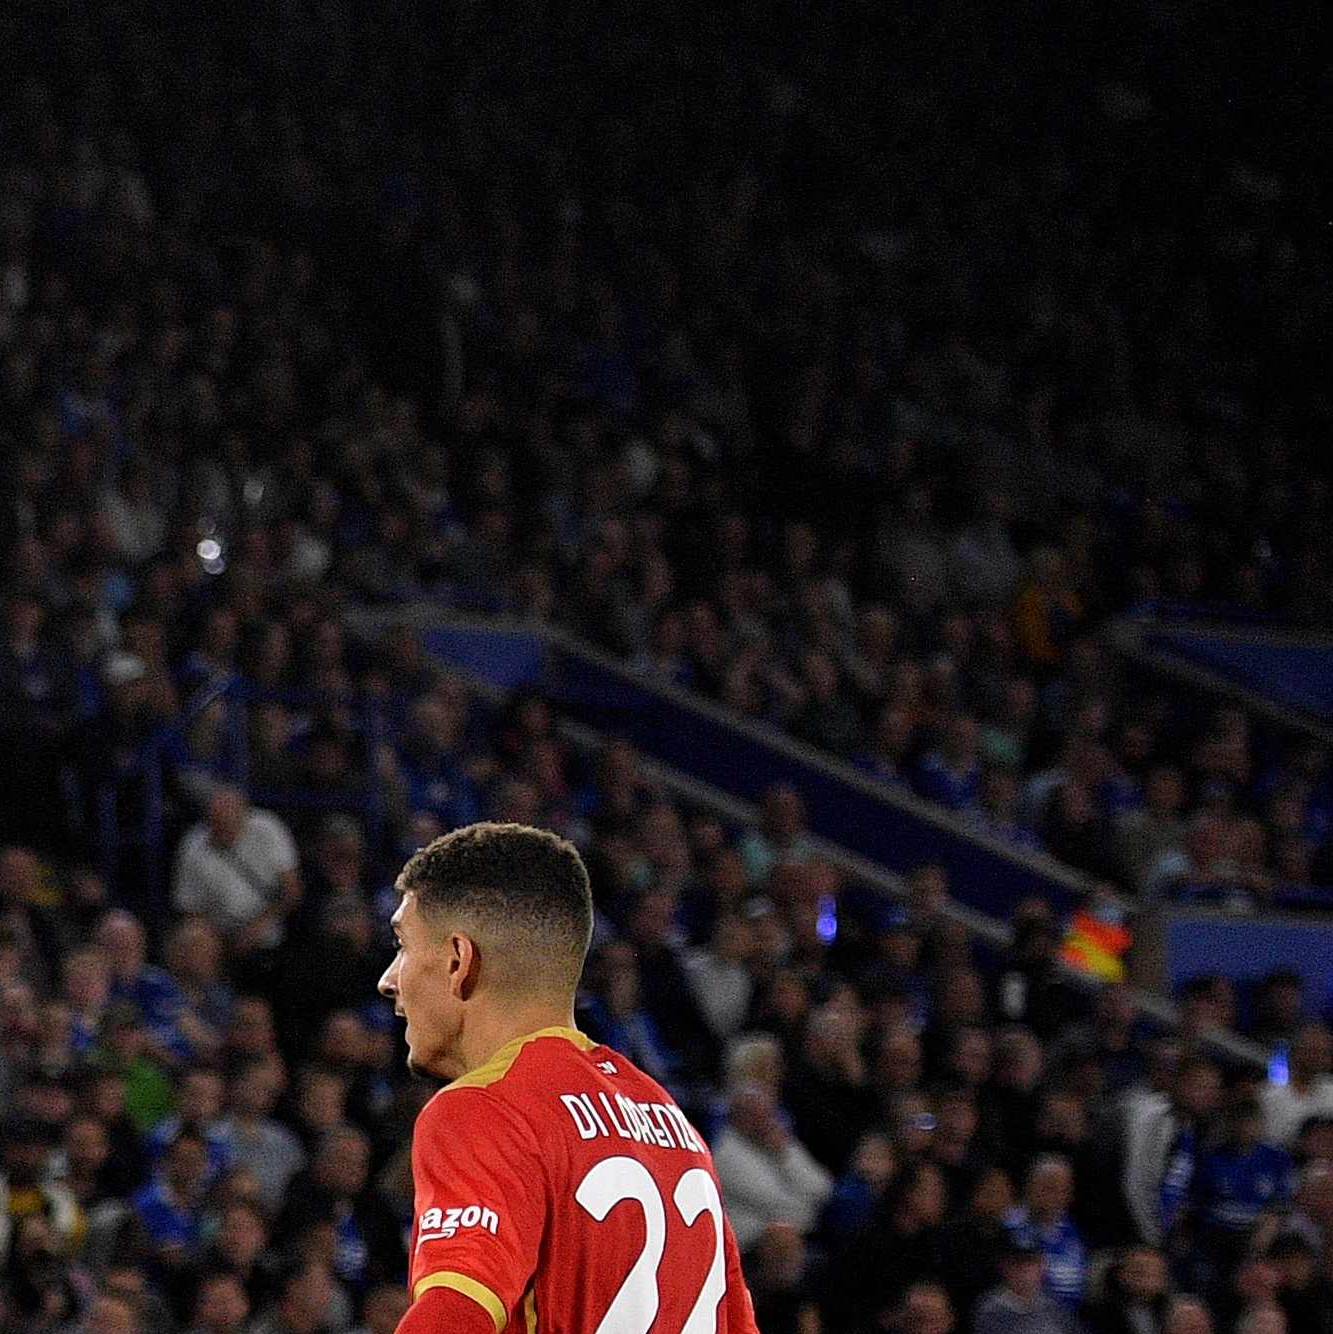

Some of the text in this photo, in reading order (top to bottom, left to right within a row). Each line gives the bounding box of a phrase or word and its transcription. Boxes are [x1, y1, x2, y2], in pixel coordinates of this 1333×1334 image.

[560, 1092, 706, 1153] DI LORENZ
[419, 1205, 499, 1235] azon
